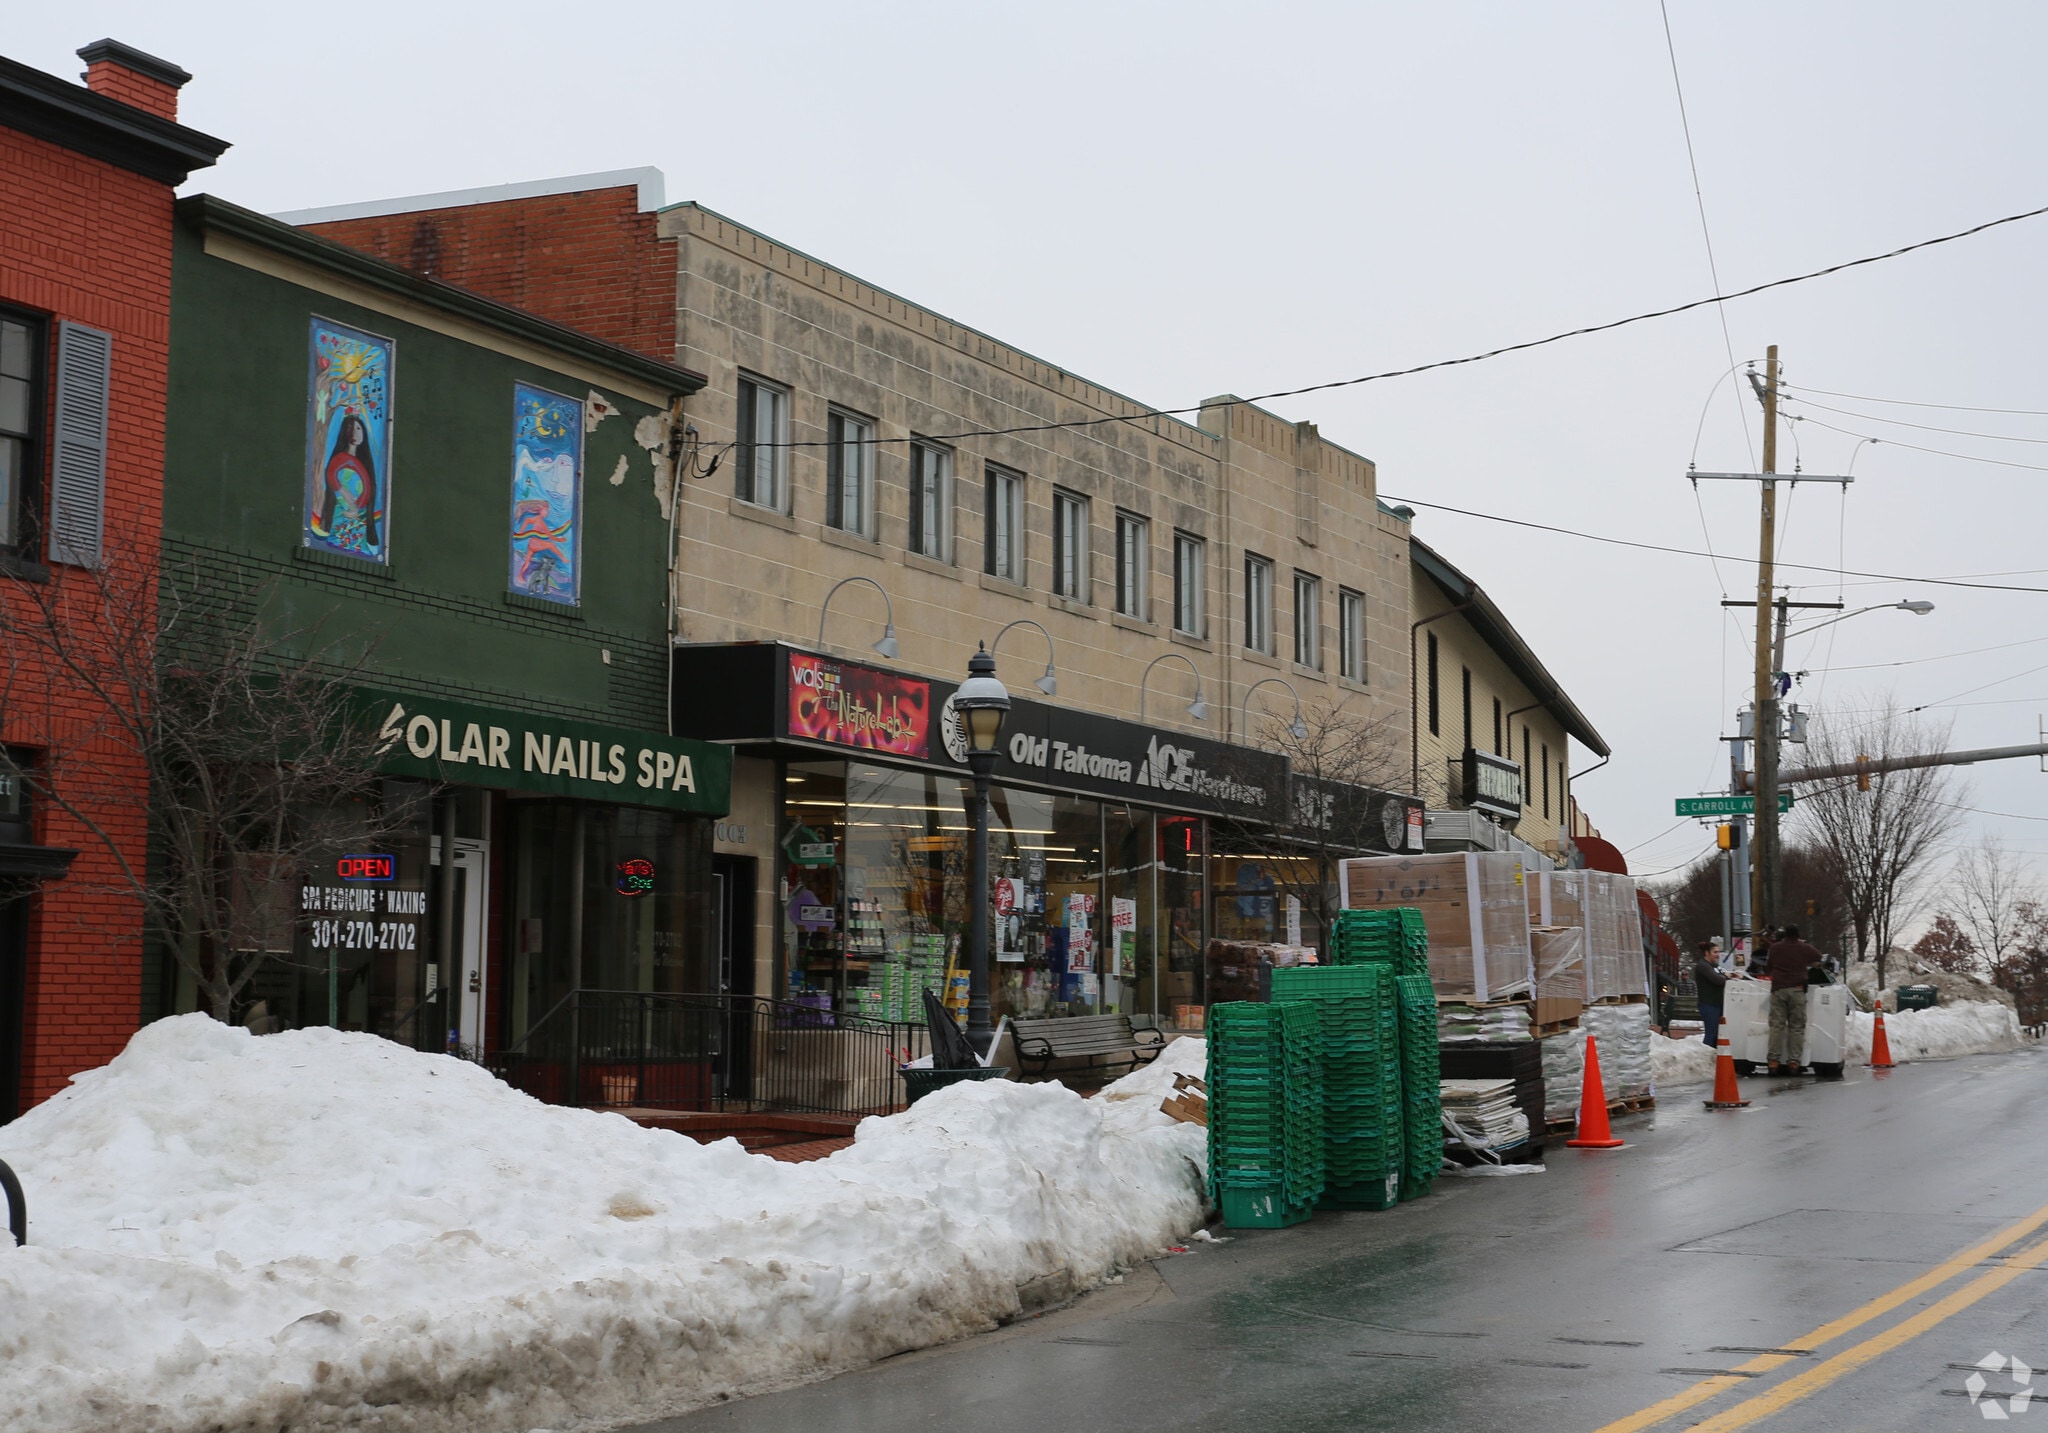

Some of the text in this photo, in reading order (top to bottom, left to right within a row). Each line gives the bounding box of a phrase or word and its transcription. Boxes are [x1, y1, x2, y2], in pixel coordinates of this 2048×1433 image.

[375, 703, 696, 794] SOLAR NAILS SPA
[1009, 733, 1049, 767] Old
[1052, 741, 1132, 783] Takoma
[1136, 735, 1195, 792] ACE
[1680, 800, 1755, 812] S. CARROLL AV
[338, 859, 390, 877] OPEN
[302, 886, 426, 914] SPA PEDICURE WAXING
[1111, 912, 1132, 927] FREE
[312, 920, 416, 950] 301-270-2702
